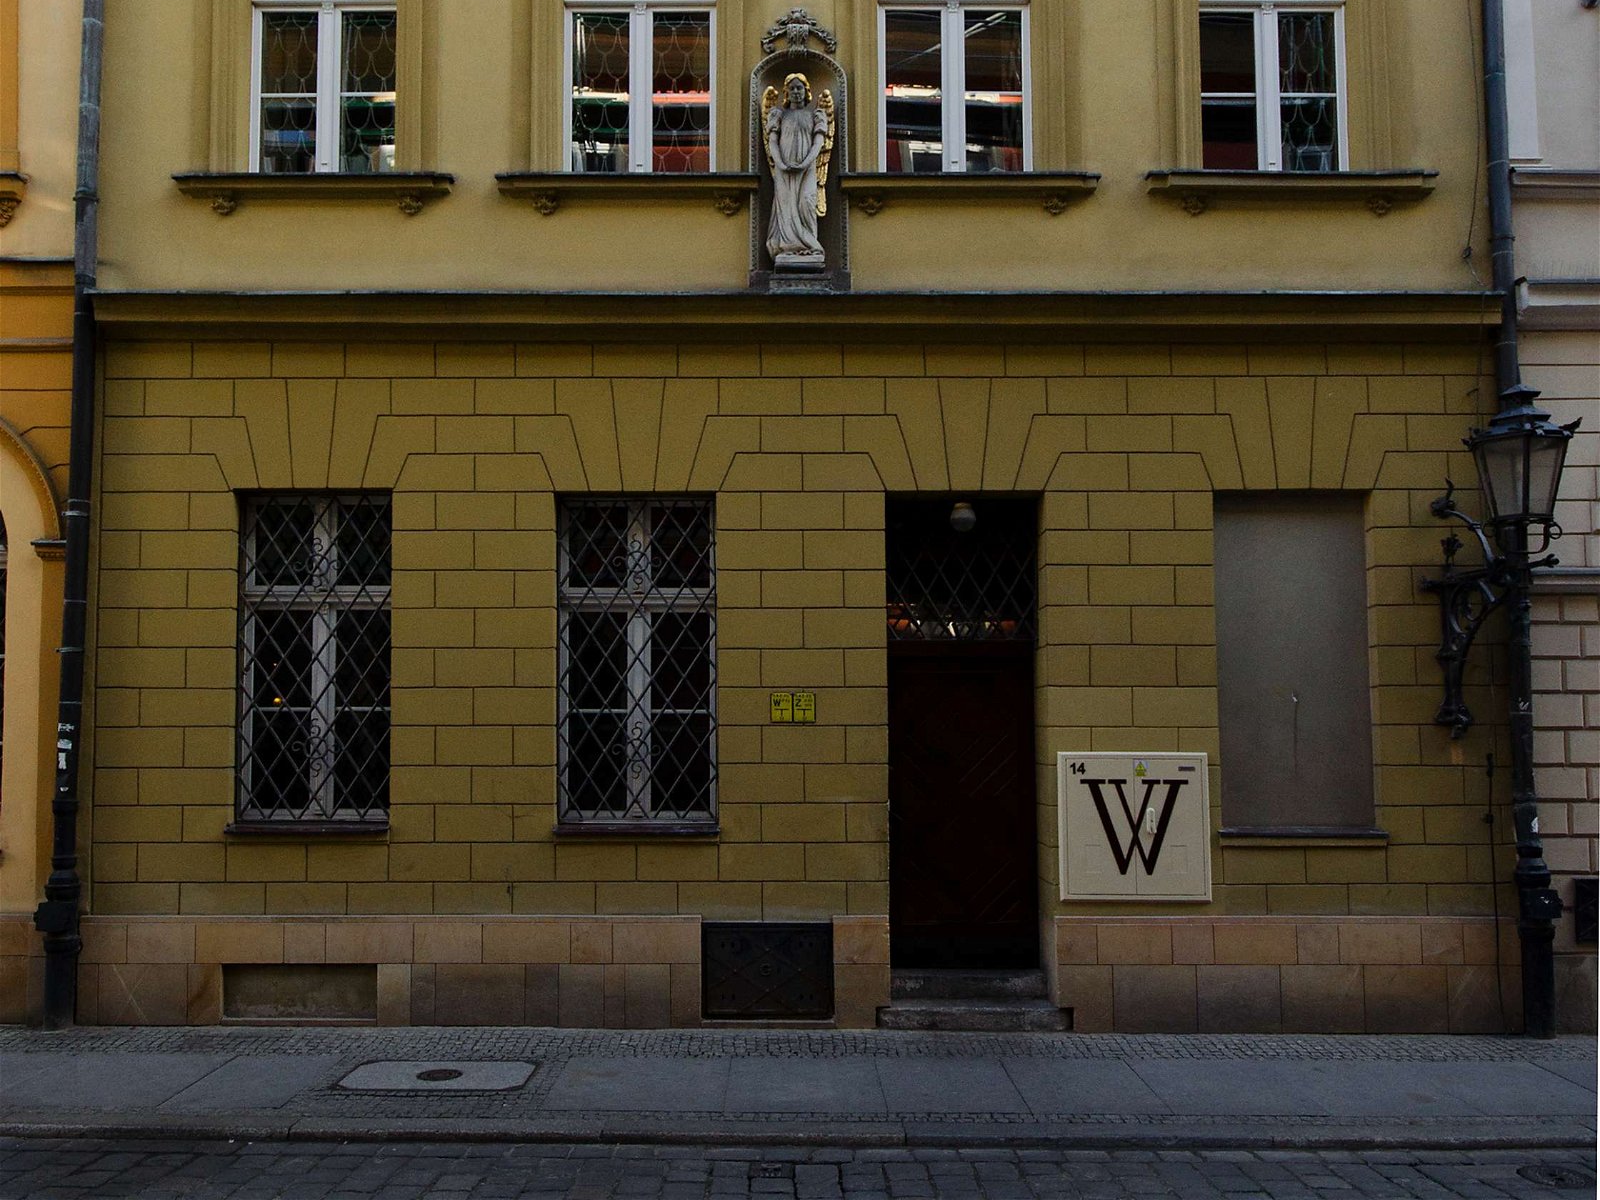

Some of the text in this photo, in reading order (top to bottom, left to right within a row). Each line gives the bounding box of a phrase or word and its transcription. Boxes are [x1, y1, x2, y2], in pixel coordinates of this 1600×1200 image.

[795, 699, 802, 707] Z
[1069, 762, 1086, 775] 14
[1080, 778, 1189, 876] W
